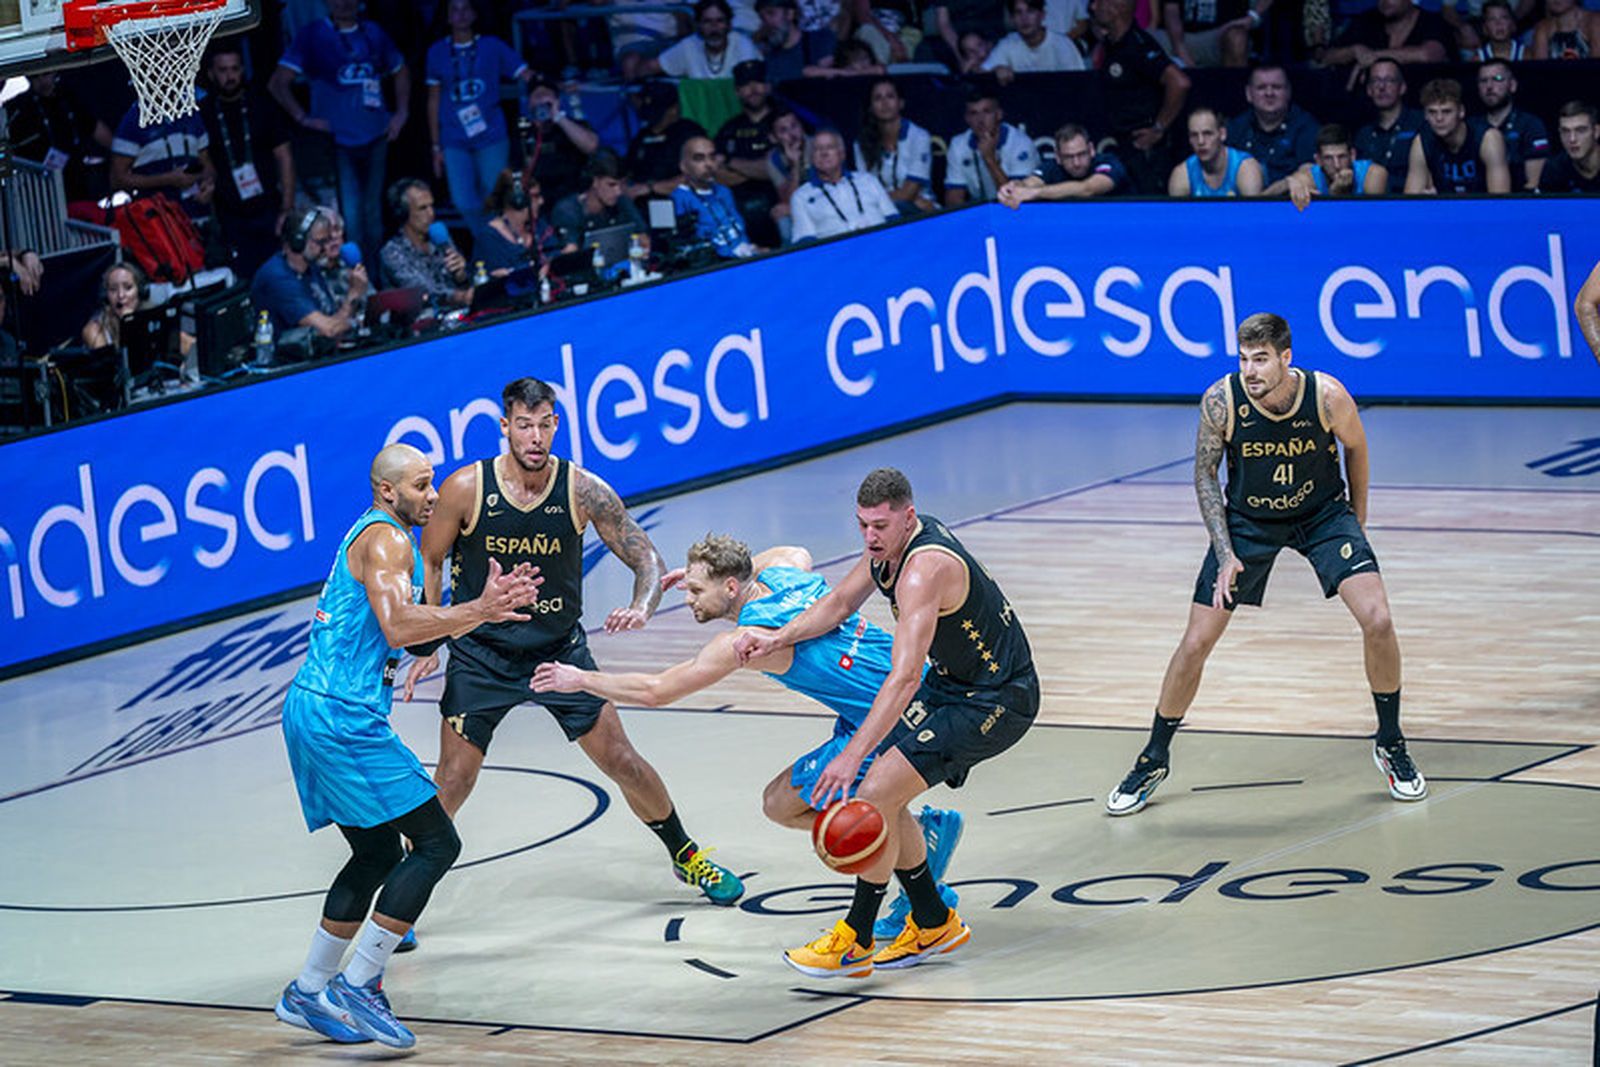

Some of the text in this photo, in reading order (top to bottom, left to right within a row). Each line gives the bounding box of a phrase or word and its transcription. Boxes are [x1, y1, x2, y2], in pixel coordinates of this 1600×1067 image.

[826, 236, 1238, 397] endesa
[1242, 437, 1317, 458] ESPAÑA
[1273, 463, 1293, 486] 41
[1246, 479, 1315, 510] endesa
[485, 533, 562, 555] ESPAÑA
